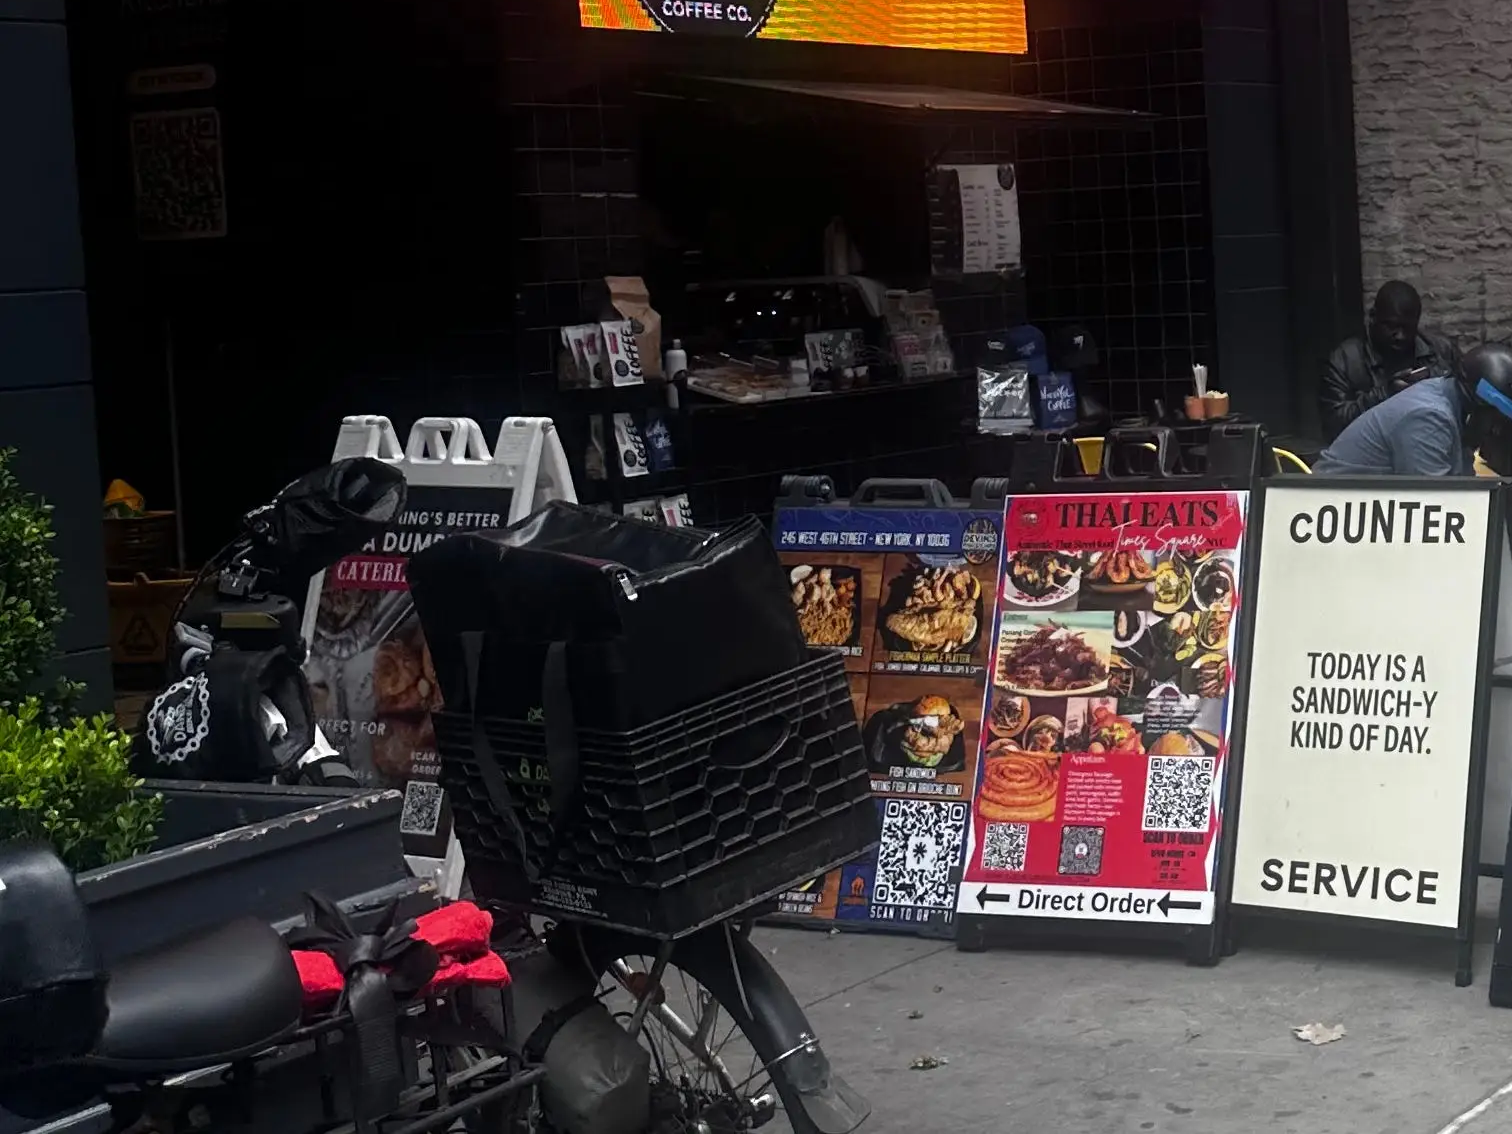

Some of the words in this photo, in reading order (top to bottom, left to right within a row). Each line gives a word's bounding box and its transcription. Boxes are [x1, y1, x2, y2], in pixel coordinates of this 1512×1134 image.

[662, 0, 722, 19] COFFEE
[727, 5, 752, 22] CO.
[621, 327, 643, 378] COFFEE
[447, 512, 500, 528] BETTER
[1055, 501, 1133, 528] THAI
[1140, 500, 1219, 528] EATS
[1289, 500, 1466, 545] COUNTER
[798, 532, 818, 544] WEST
[819, 532, 839, 545] 46TH
[840, 532, 868, 545] STREET
[875, 533, 892, 545] NEW
[915, 534, 926, 546] NY
[1154, 522, 1206, 561] Square
[337, 561, 408, 583] CATERI
[1307, 653, 1381, 681] TODAY
[1386, 654, 1406, 682] IS
[1411, 655, 1426, 683] A
[1291, 686, 1438, 718] SANDWICH-Y
[361, 722, 386, 736] FOR
[1290, 721, 1343, 750] KIND
[1349, 723, 1379, 752] OF
[1384, 725, 1432, 755] DAY.
[1260, 858, 1439, 904] SERVICE
[870, 906, 894, 919] SCAN
[900, 908, 911, 921] TO
[1018, 889, 1085, 912] Direct
[1091, 891, 1156, 914] Order
